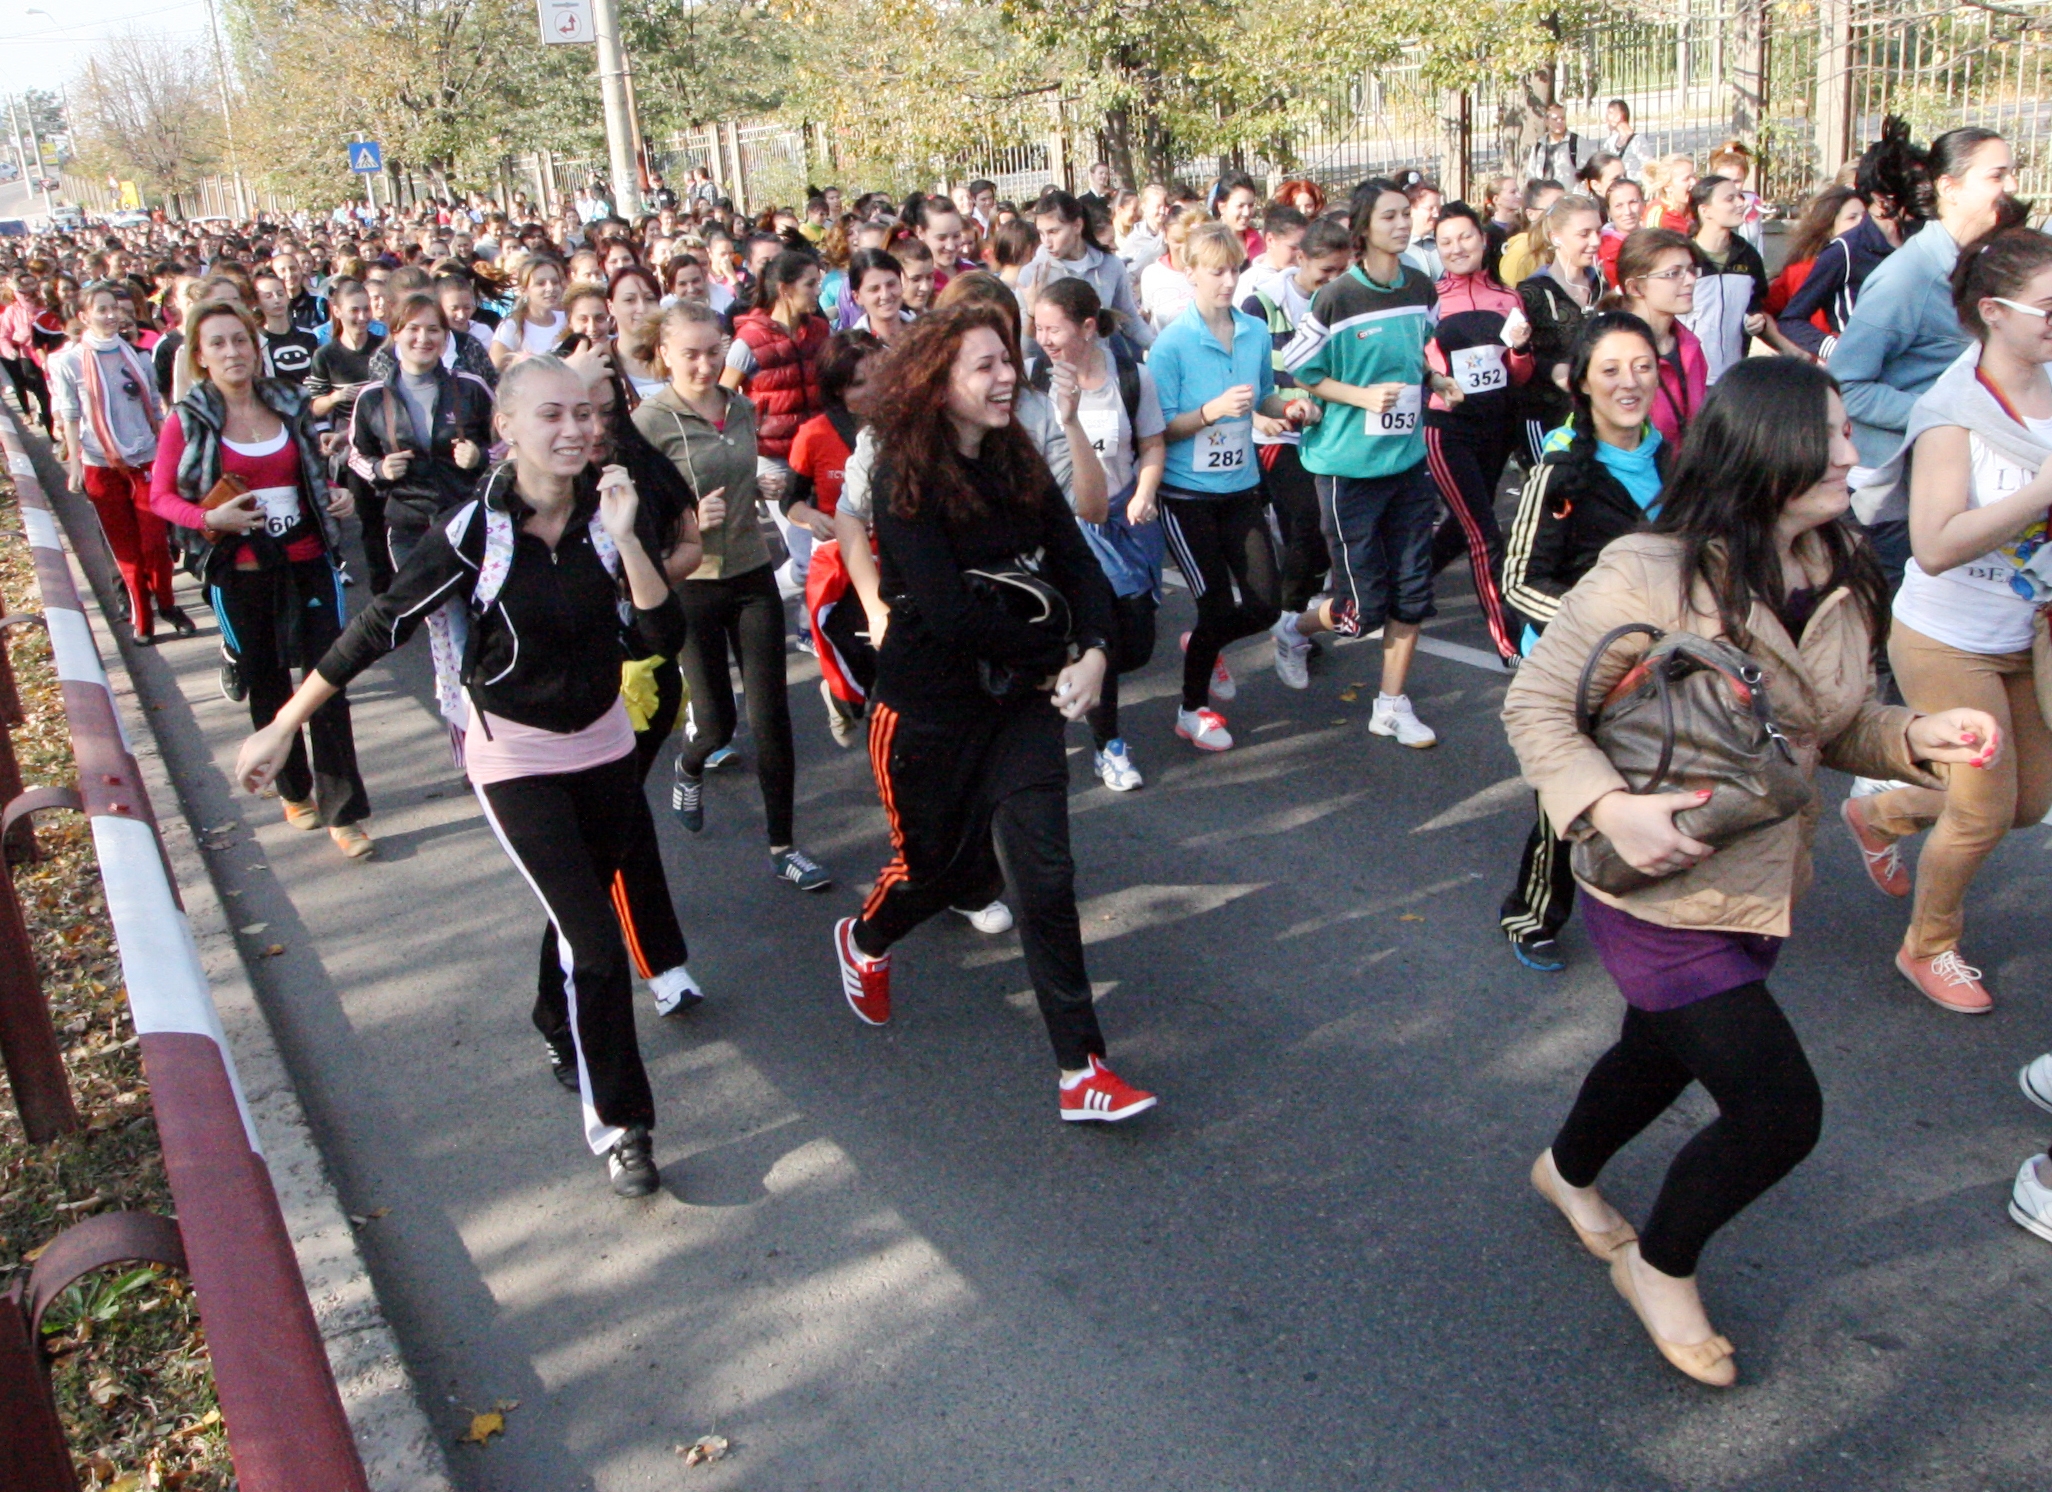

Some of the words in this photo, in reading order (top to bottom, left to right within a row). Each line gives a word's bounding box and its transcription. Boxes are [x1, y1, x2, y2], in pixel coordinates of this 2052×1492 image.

[1469, 368, 1501, 388] 352
[1381, 412, 1416, 430] 053
[1092, 438, 1106, 452] 4
[1207, 448, 1243, 468] 282
[266, 515, 294, 534] 60
